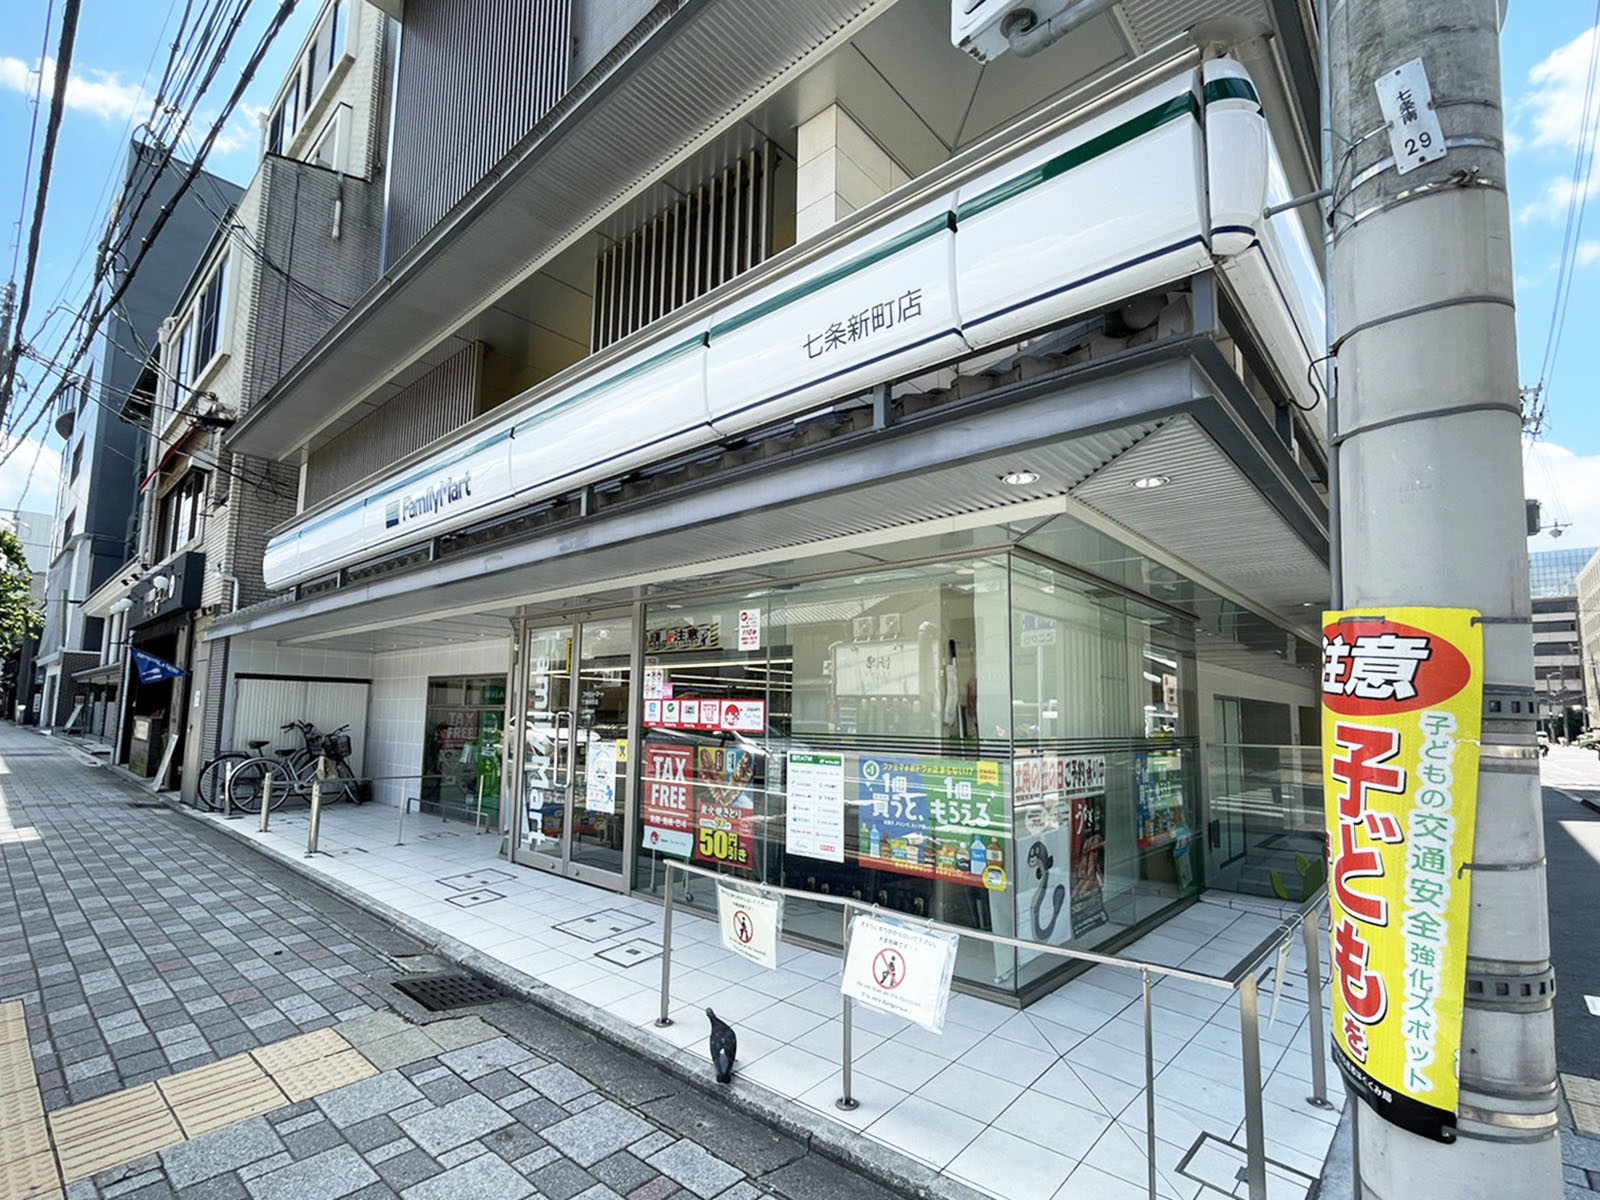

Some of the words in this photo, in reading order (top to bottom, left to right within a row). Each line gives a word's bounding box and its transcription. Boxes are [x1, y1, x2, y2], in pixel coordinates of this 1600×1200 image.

[1404, 131, 1432, 156] 29
[802, 288, 922, 359] 七条新町店
[402, 470, 471, 522] FamilyMart
[1322, 634, 1433, 702] 注意
[652, 756, 686, 784] TAX
[651, 784, 687, 810] FREE
[943, 776, 972, 800] 1個
[930, 798, 991, 828] もらえる
[1407, 714, 1451, 1087] 子どもの交通安全強化スポット
